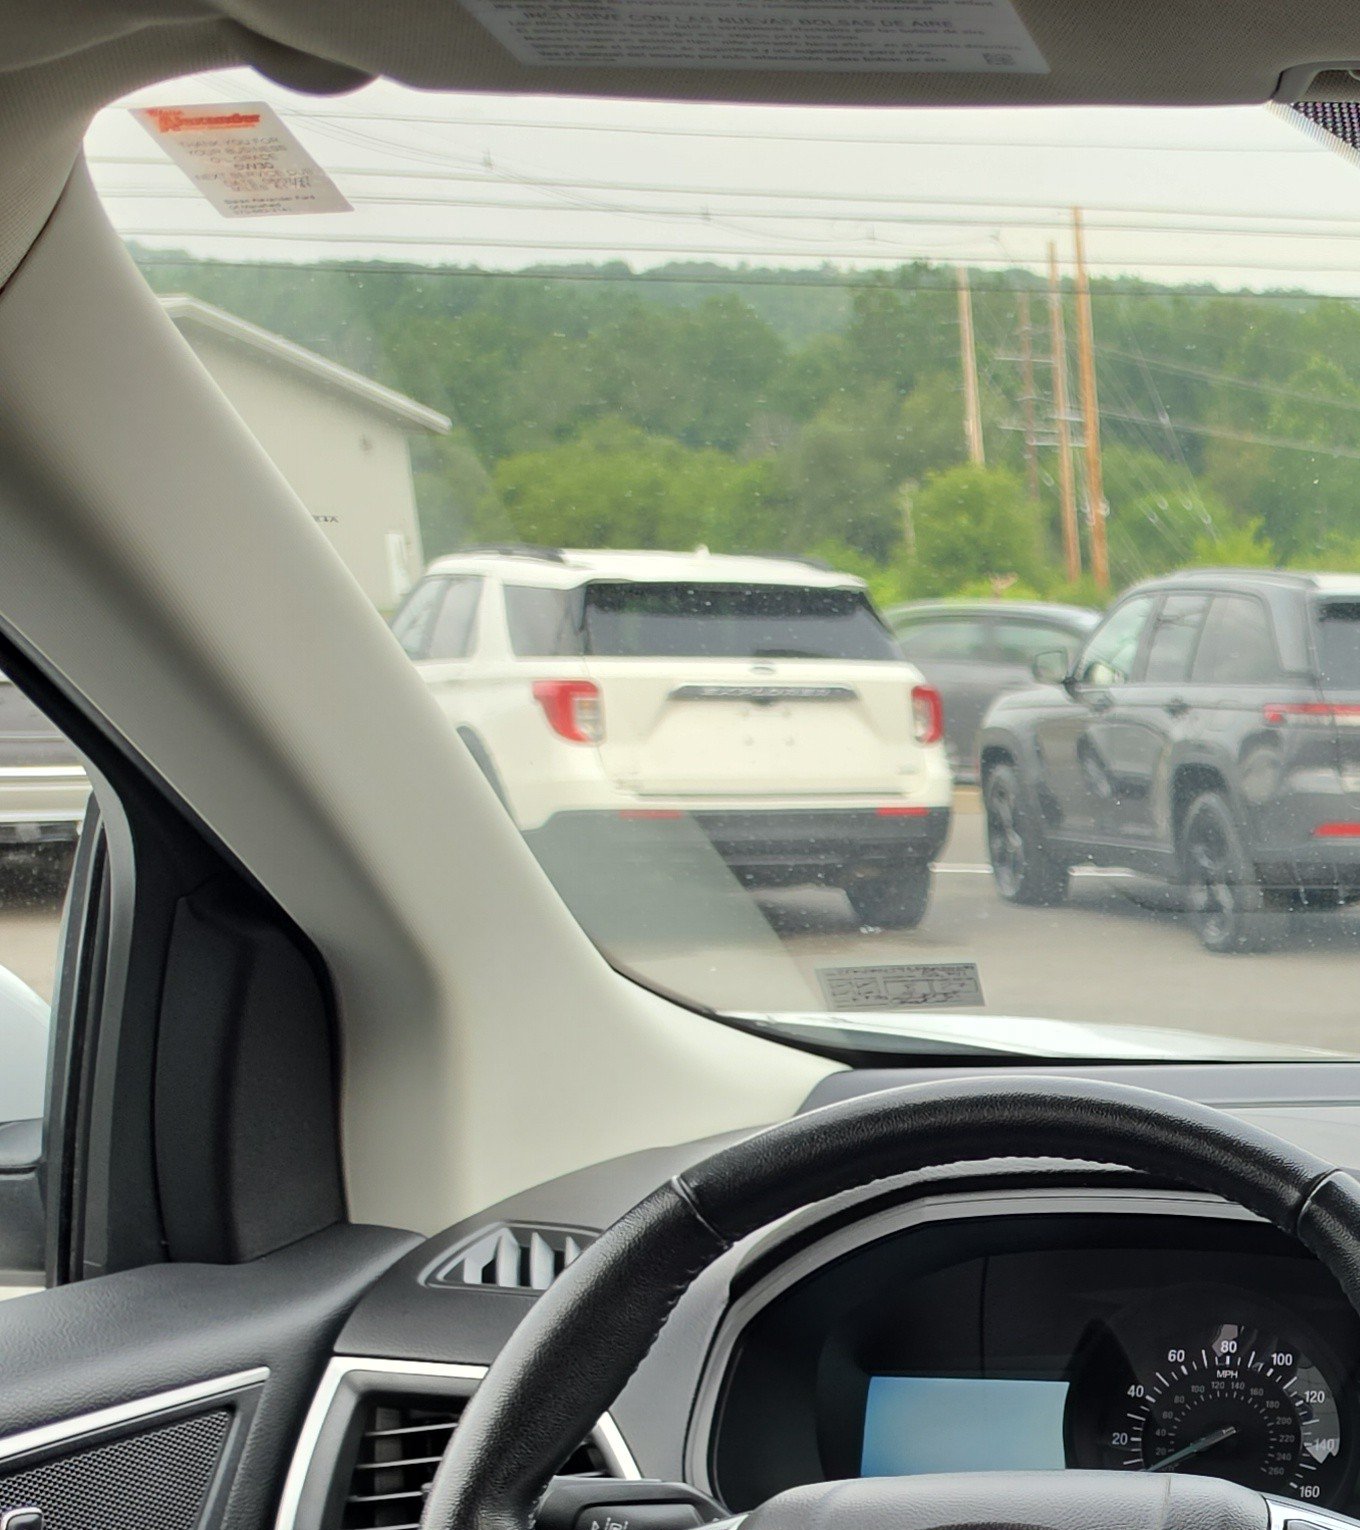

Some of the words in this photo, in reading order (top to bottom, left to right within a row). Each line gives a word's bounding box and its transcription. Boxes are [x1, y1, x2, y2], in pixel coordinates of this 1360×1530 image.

[1220, 1341, 1237, 1353] 80
[1168, 1350, 1185, 1362] 60
[1271, 1353, 1293, 1366] 100
[1216, 1370, 1238, 1379] MPH
[1127, 1385, 1144, 1397] 40
[1304, 1390, 1325, 1403] 120
[1112, 1433, 1128, 1445] 20
[1313, 1439, 1335, 1451] 140
[1300, 1486, 1320, 1498] 160
